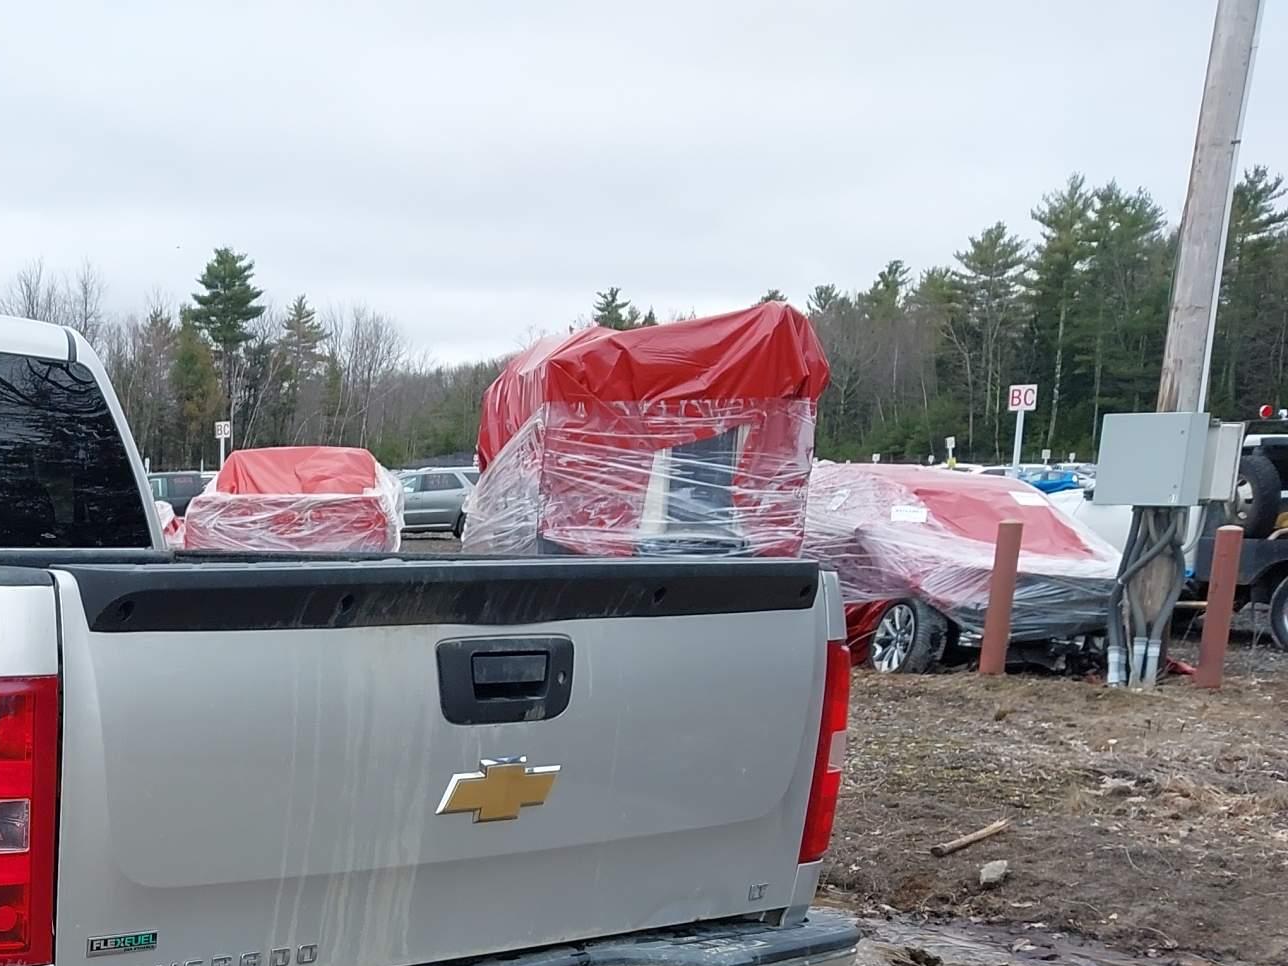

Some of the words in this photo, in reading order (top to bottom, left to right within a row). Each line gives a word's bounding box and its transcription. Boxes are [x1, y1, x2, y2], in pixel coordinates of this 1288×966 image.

[1011, 388, 1035, 407] BC
[748, 882, 769, 902] LT
[91, 932, 158, 952] FLEXFUEL
